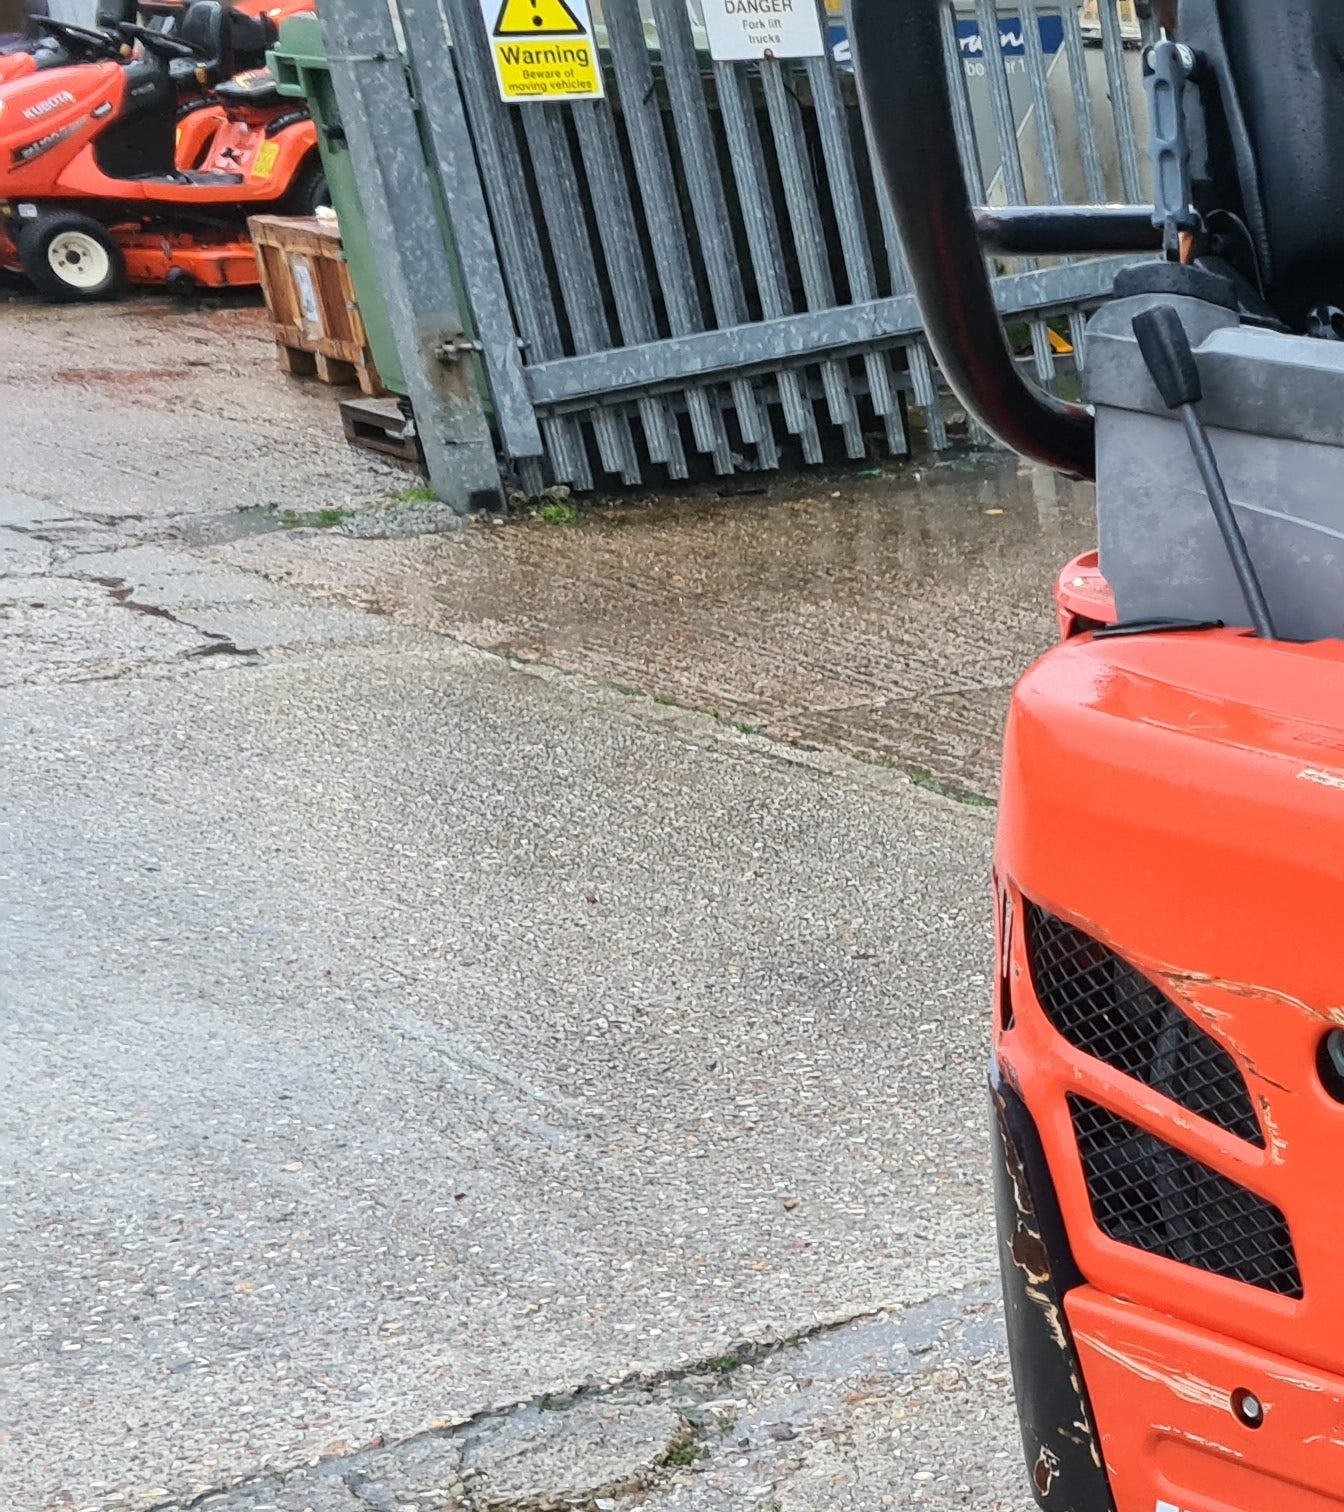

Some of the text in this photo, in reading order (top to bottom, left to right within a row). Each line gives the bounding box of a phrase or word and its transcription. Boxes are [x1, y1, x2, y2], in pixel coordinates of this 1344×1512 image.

[724, 0, 793, 14] DANGER
[742, 19, 782, 30] Fork lift
[748, 34, 781, 44] trucks
[499, 44, 589, 67] Warning
[522, 69, 574, 79] Beware of
[508, 80, 592, 92] moving vehicles
